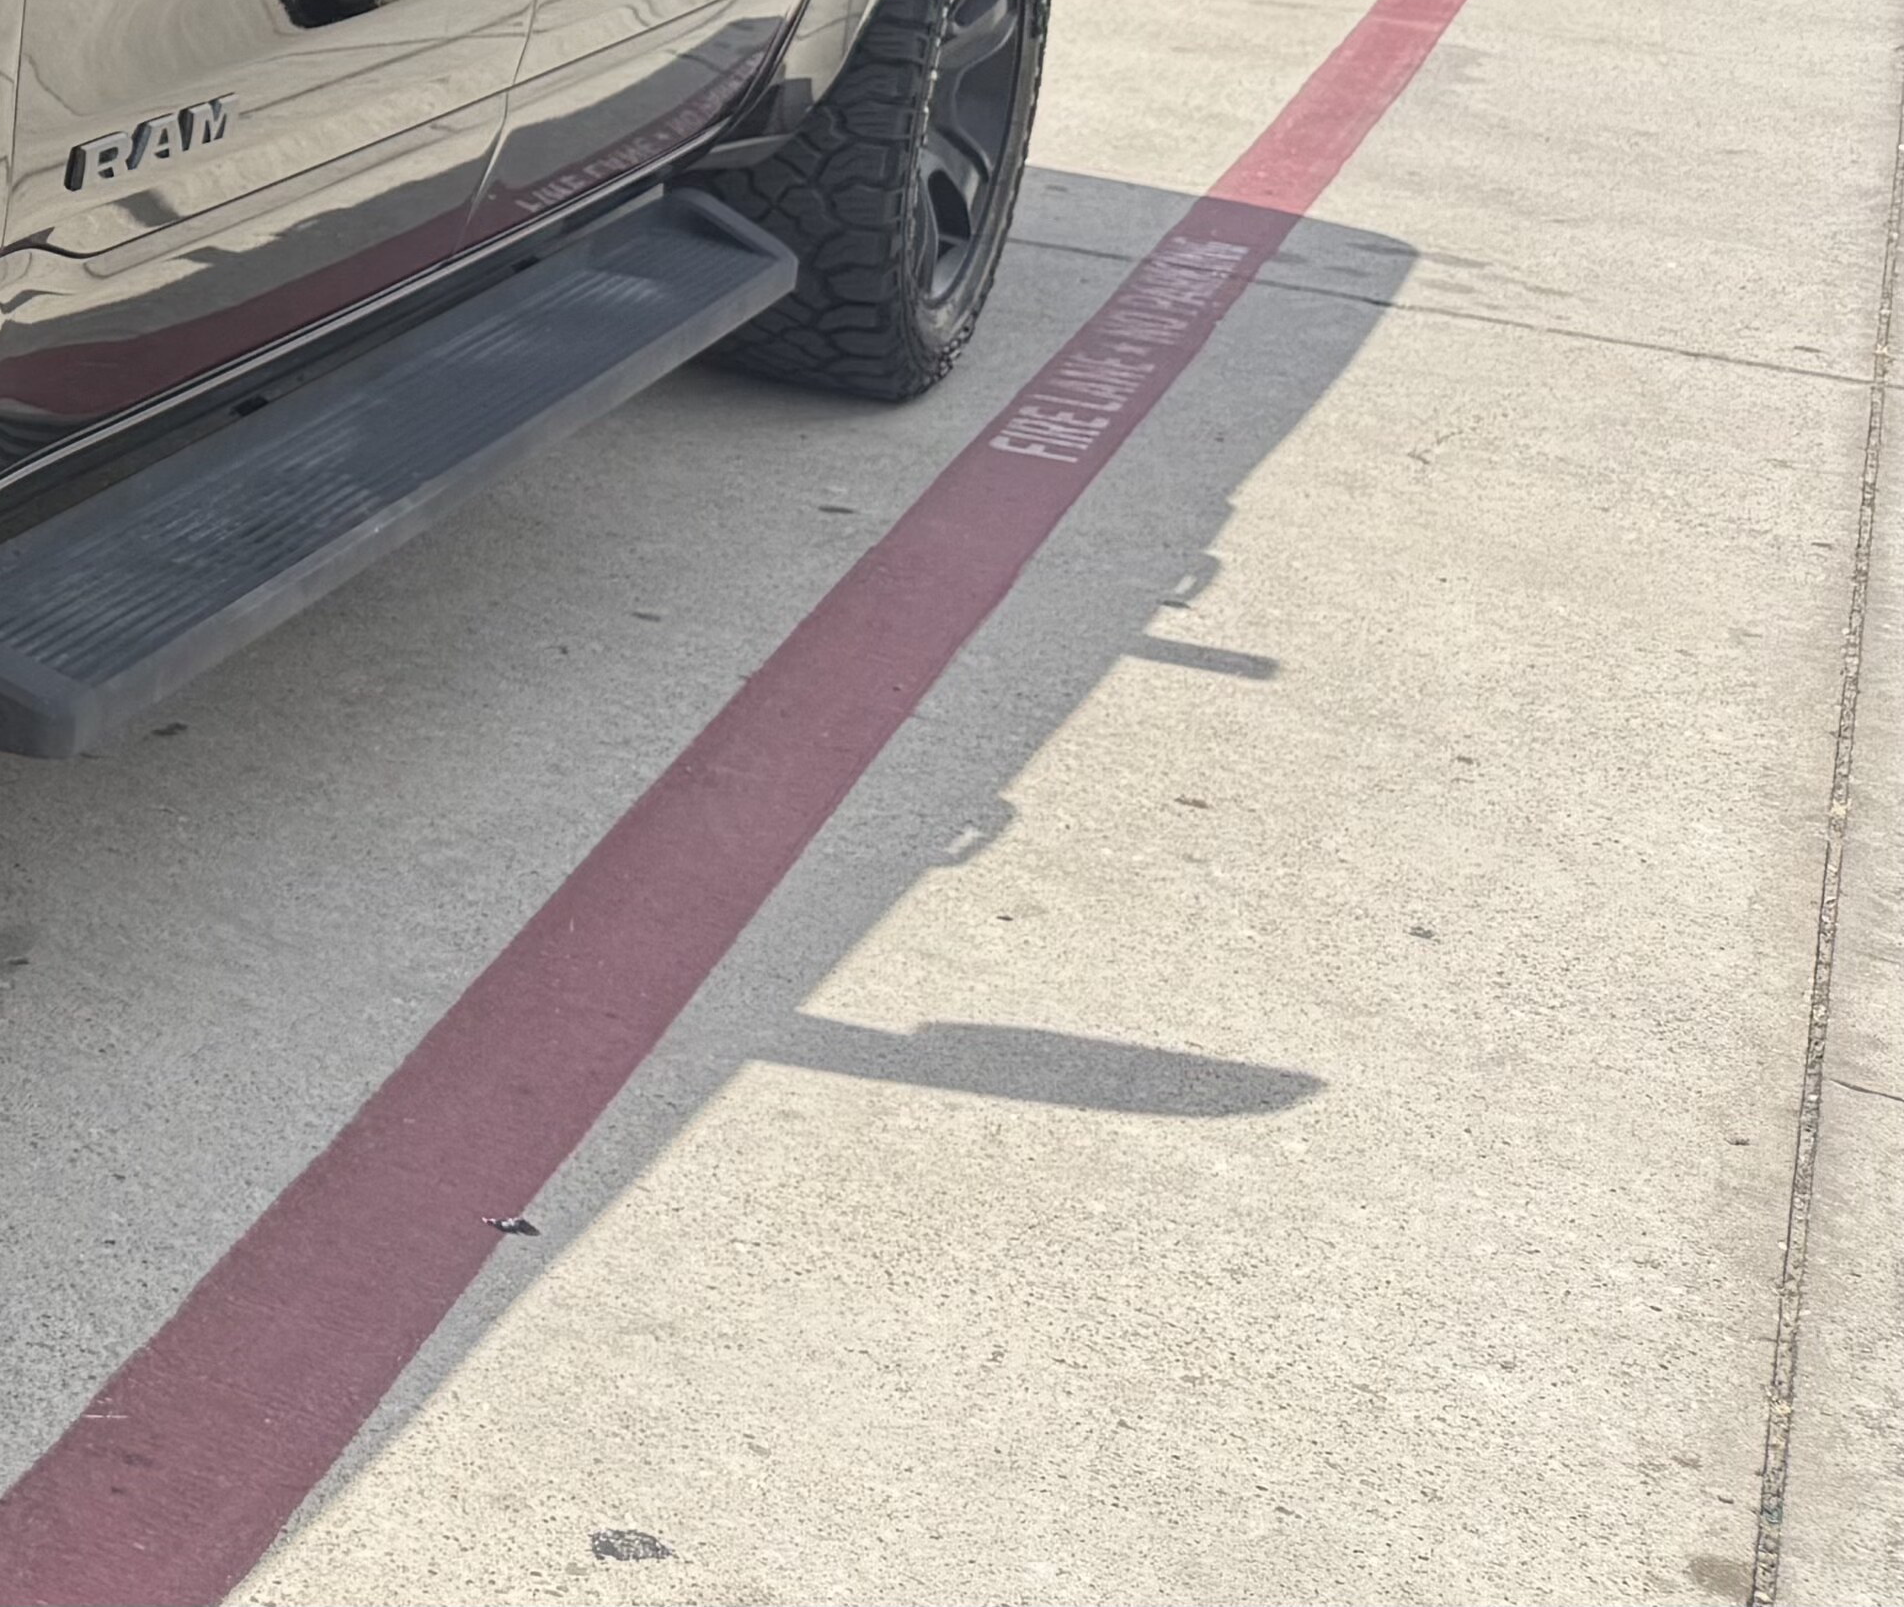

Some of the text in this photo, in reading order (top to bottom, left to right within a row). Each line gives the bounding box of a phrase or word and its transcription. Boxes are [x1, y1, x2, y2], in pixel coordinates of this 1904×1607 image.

[64, 92, 240, 192] RAM
[1033, 352, 1155, 412] LANE
[989, 405, 1111, 463] FIRE
